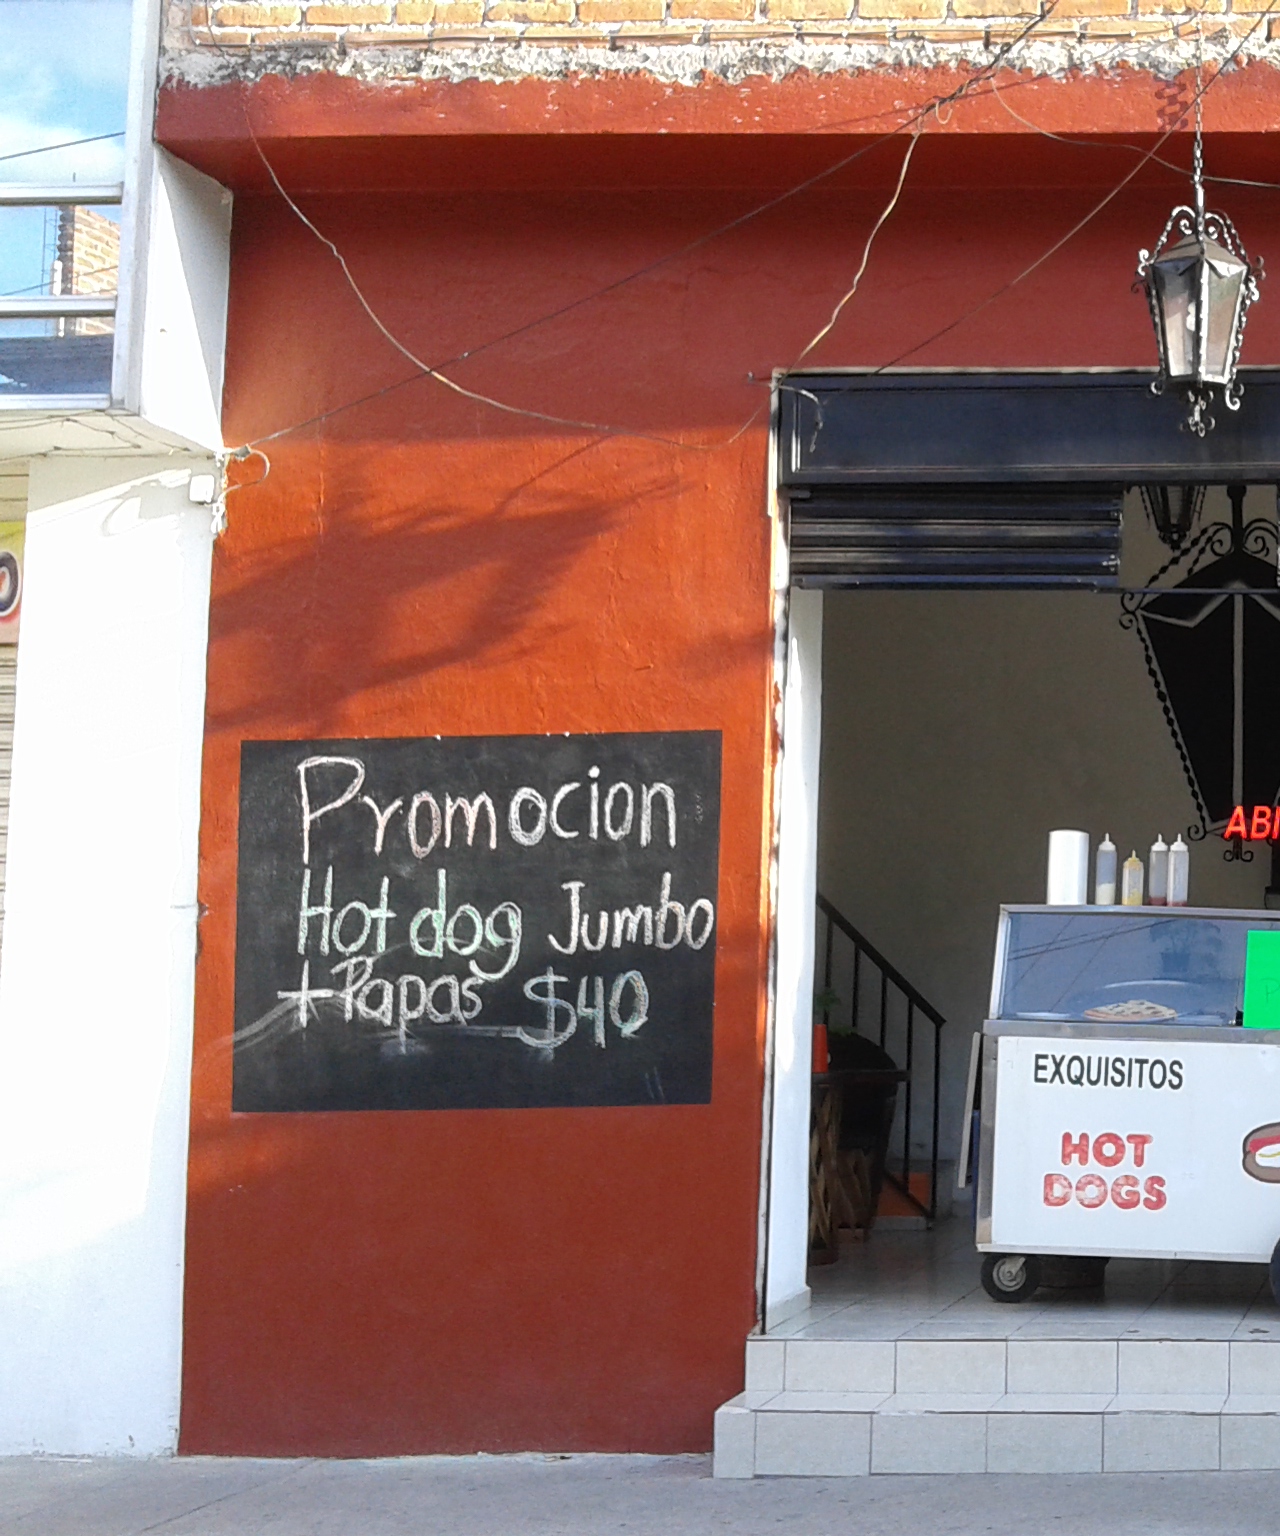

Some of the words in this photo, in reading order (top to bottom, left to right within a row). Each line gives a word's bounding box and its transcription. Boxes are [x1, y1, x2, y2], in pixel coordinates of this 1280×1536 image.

[548, 872, 714, 956] Jumbo
[523, 966, 649, 1061] $40
[1033, 1053, 1184, 1090] EXQUISITOS
[1061, 1131, 1153, 1168] HOT
[1043, 1173, 1167, 1211] DOGS
